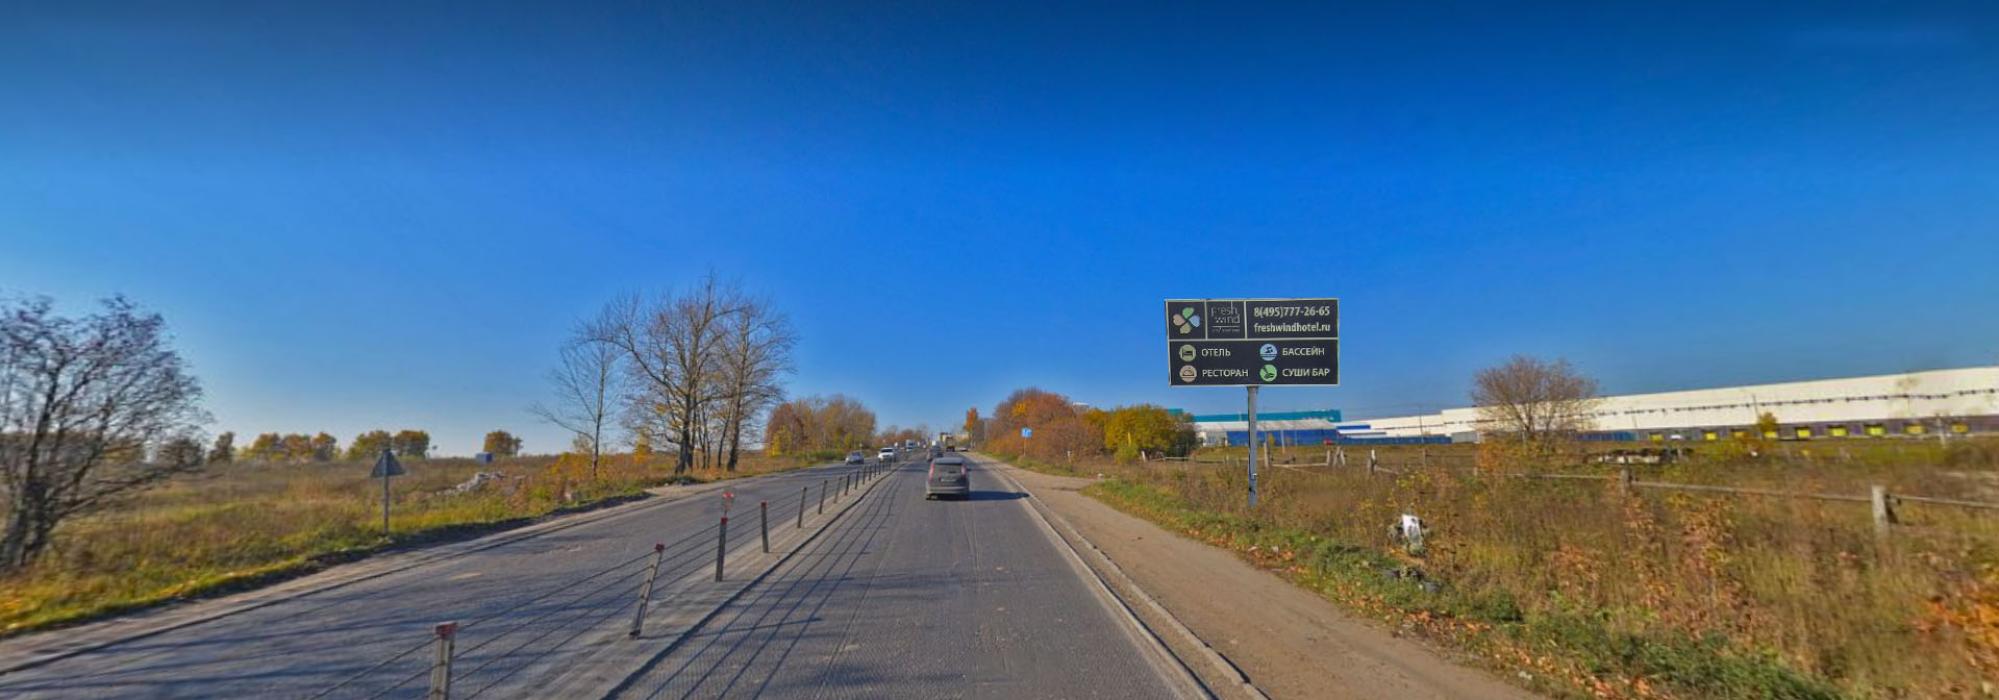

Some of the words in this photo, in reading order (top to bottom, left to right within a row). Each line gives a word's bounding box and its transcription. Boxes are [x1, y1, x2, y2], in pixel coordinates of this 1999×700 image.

[1254, 306, 1330, 318] 8(495)777-26-65
[1254, 322, 1330, 333] freshwindhotel.ru
[1201, 348, 1231, 357] ОТЕЛЬ
[1282, 346, 1325, 356] БАССЕЙН
[1202, 369, 1249, 377] РЕСТОРАН
[1282, 368, 1310, 377] СУШИ
[1312, 368, 1330, 377] БАР
